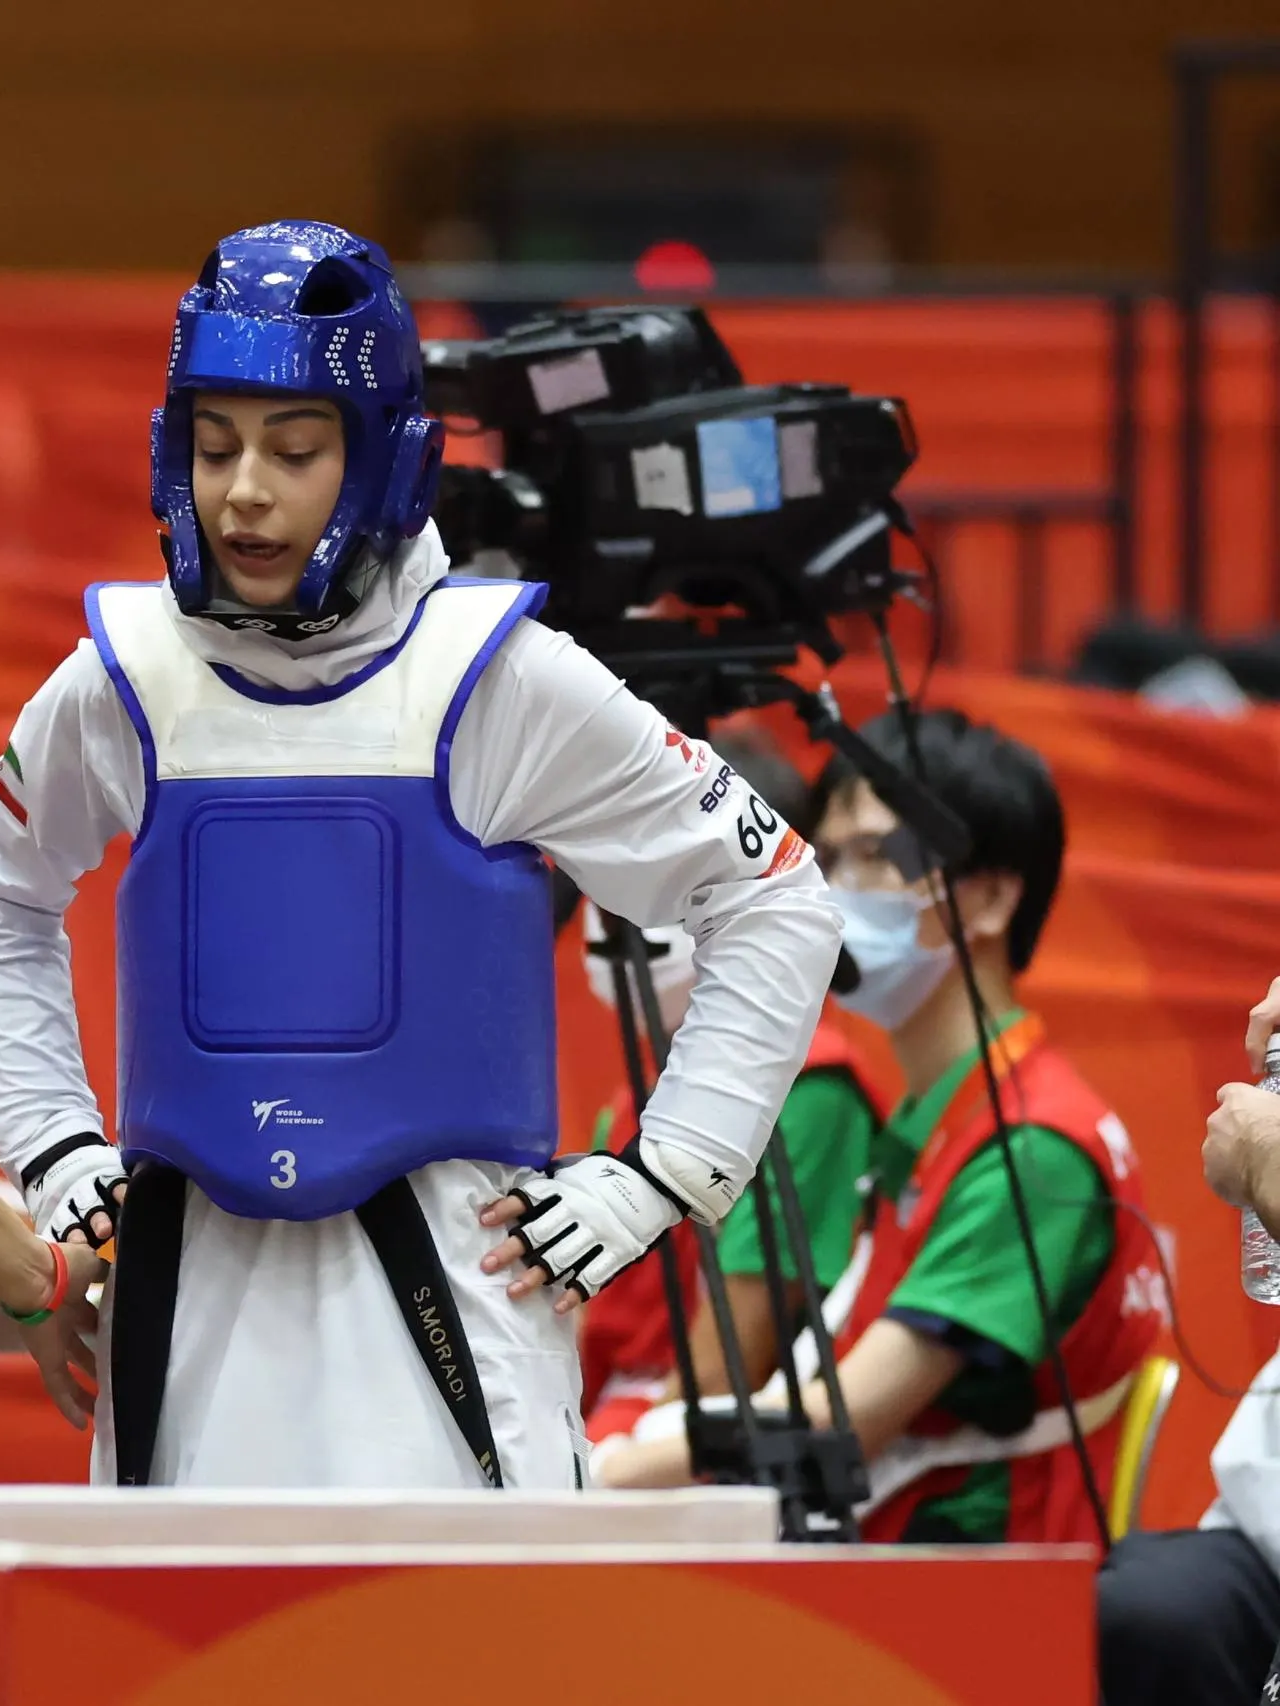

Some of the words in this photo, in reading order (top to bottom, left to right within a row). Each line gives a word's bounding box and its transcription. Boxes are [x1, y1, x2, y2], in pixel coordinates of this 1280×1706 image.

[737, 794, 777, 859] 60
[270, 1150, 297, 1190] 3
[414, 1286, 467, 1402] S.MORADI
